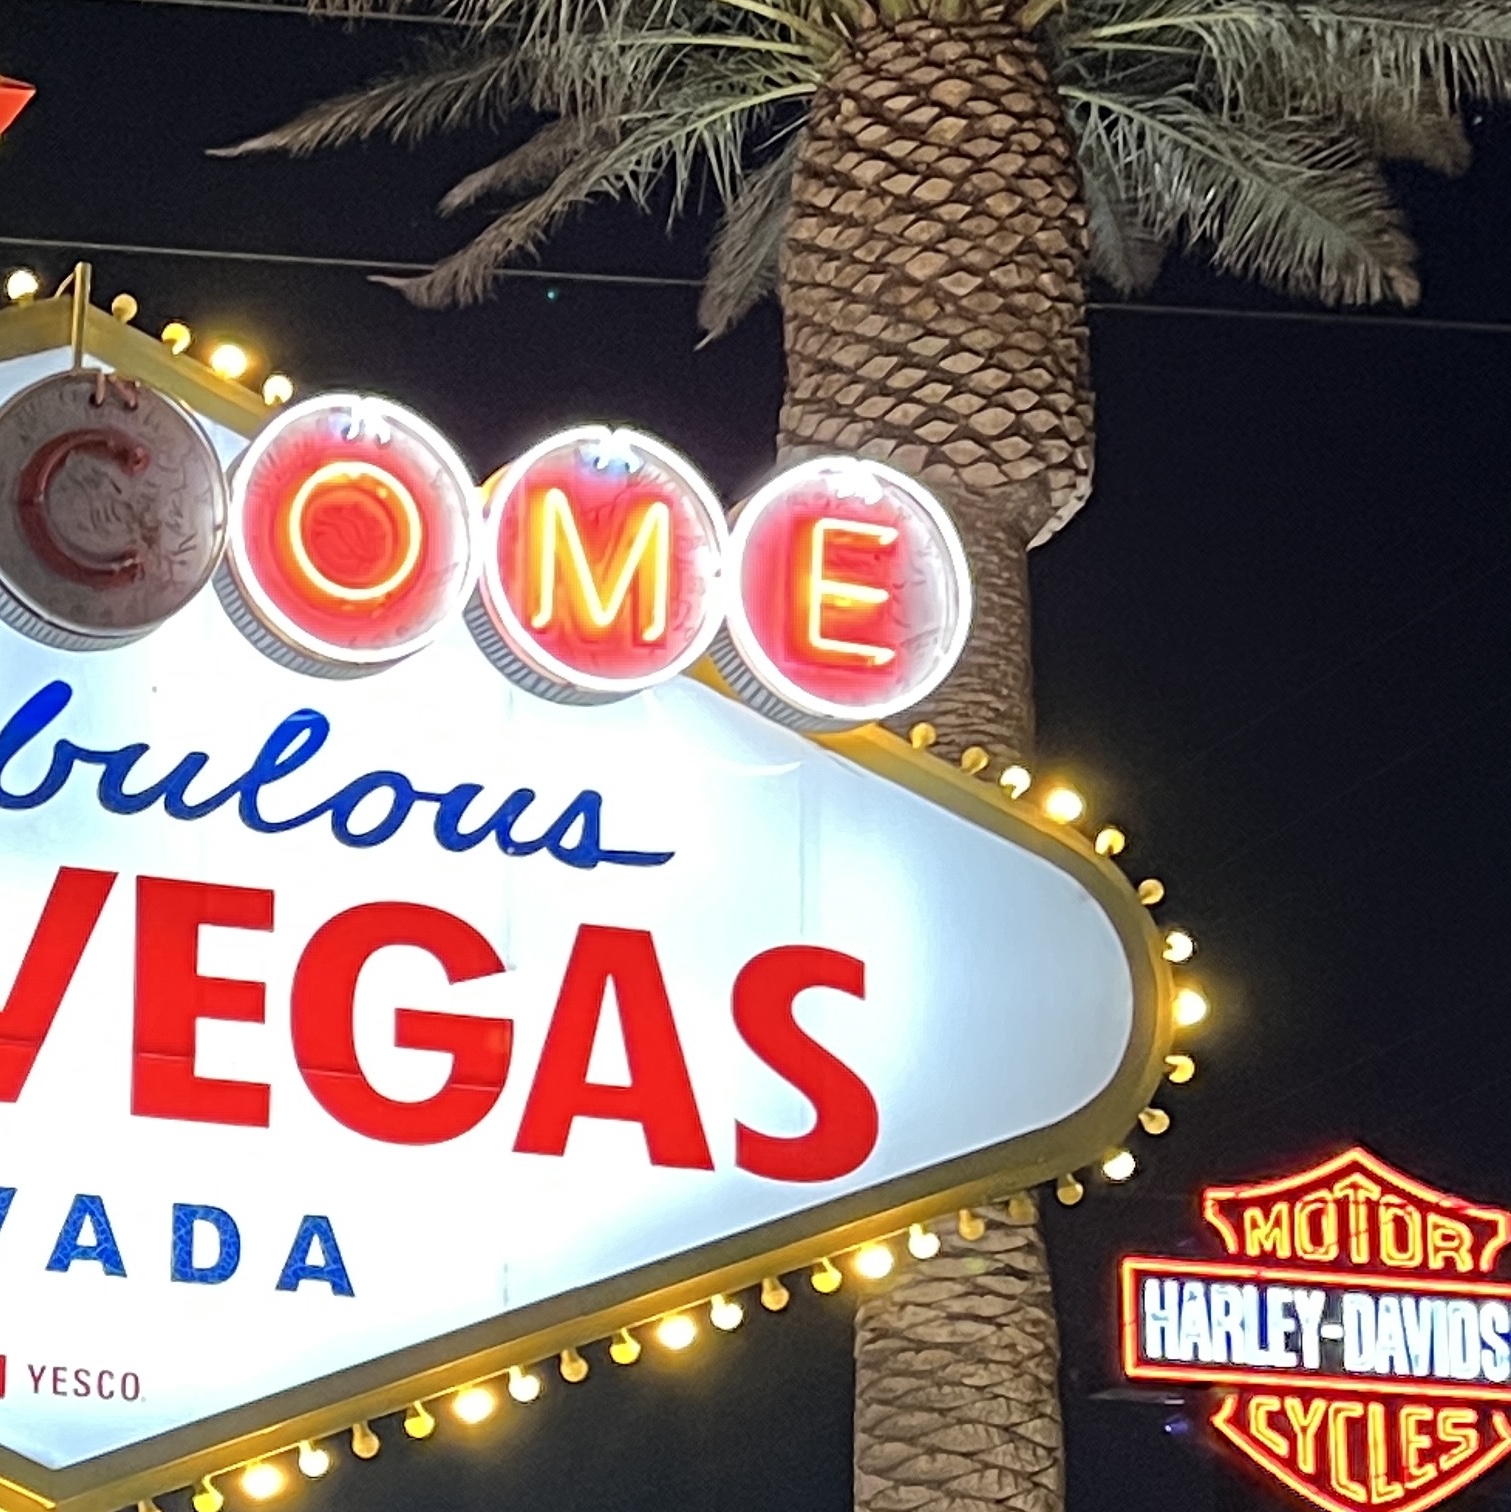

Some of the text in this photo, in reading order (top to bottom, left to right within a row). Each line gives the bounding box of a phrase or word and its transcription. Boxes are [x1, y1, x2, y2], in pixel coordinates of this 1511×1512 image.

[1243, 1172, 1474, 1273] MOTOR
[27, 1363, 141, 1402] YESCO
[1249, 1394, 1480, 1505] CYCLES
